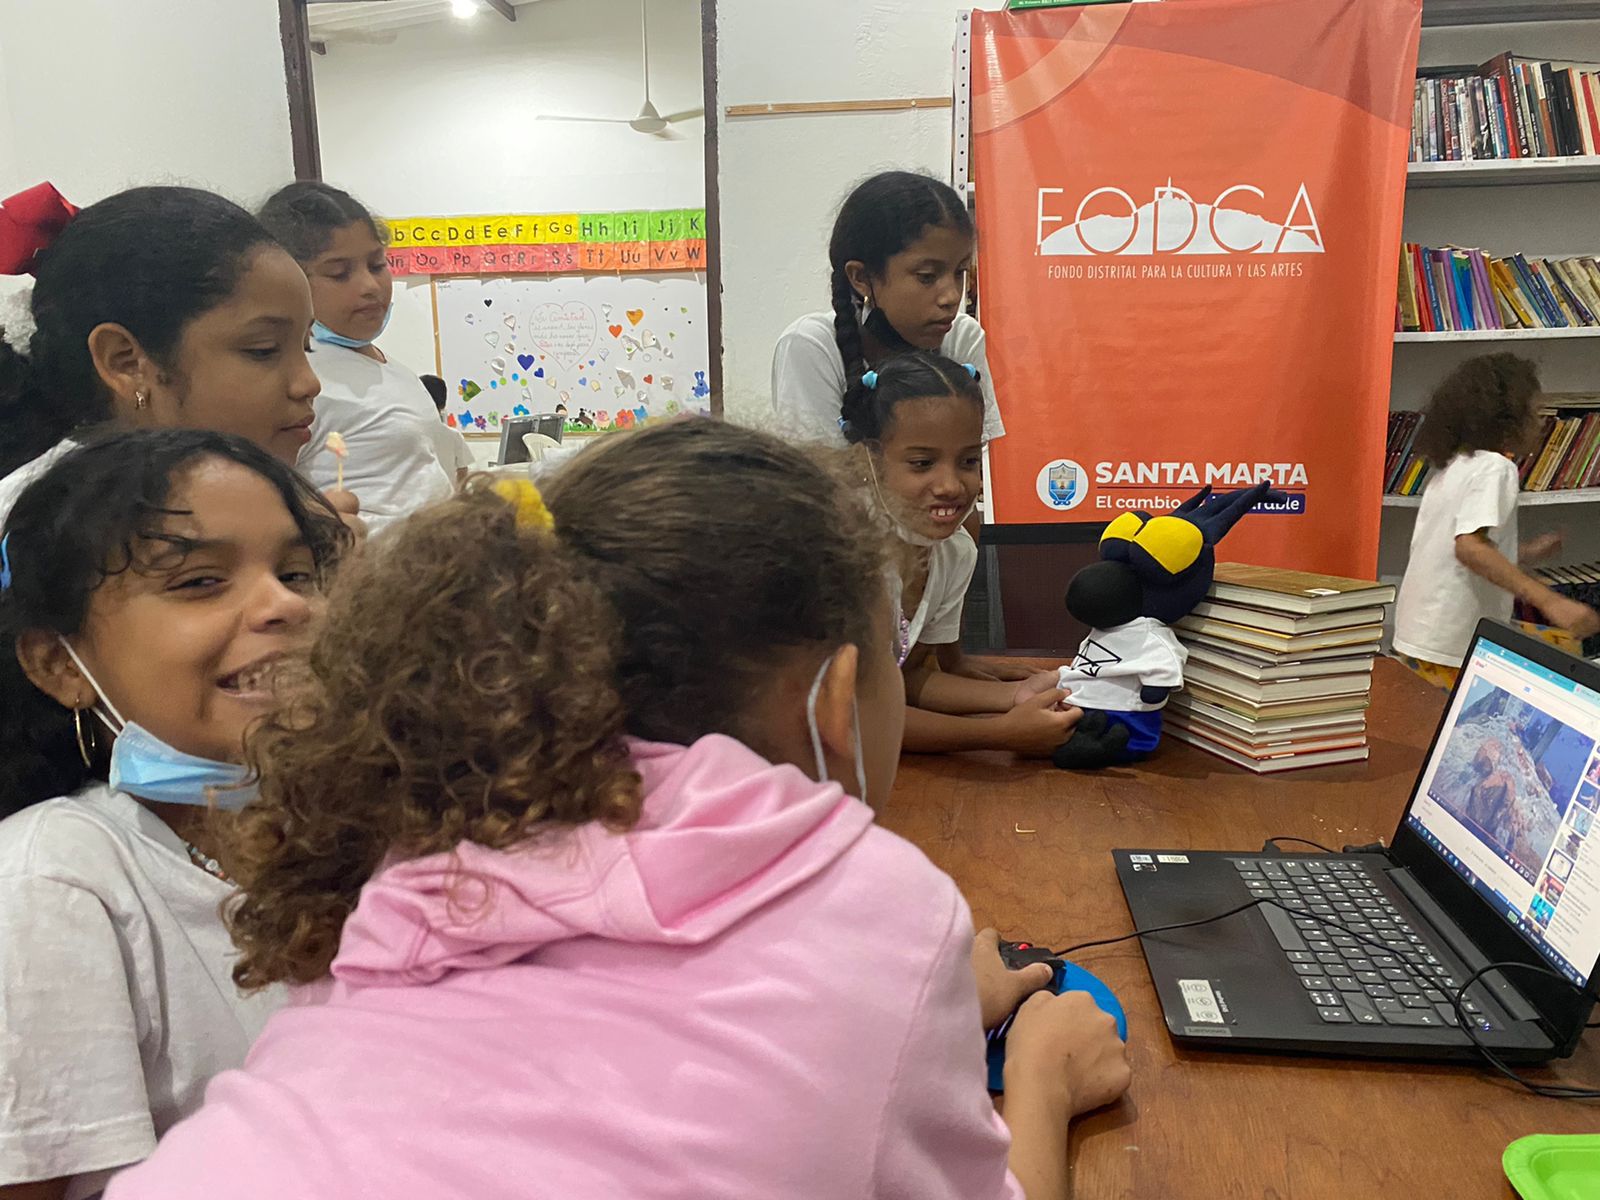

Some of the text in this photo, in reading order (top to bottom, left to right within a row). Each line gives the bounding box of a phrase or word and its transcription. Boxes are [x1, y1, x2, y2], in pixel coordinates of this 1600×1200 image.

[690, 218, 699, 230] K
[1034, 178, 1325, 255] FODCA
[687, 247, 700, 260] W
[1048, 262, 1303, 279] FONDO DISTRITAL PARA LA CULTURA Y LAS ARTES
[1095, 461, 1309, 485] SANTA MARTA
[1096, 495, 1112, 508] El
[1115, 495, 1182, 509] cambio
